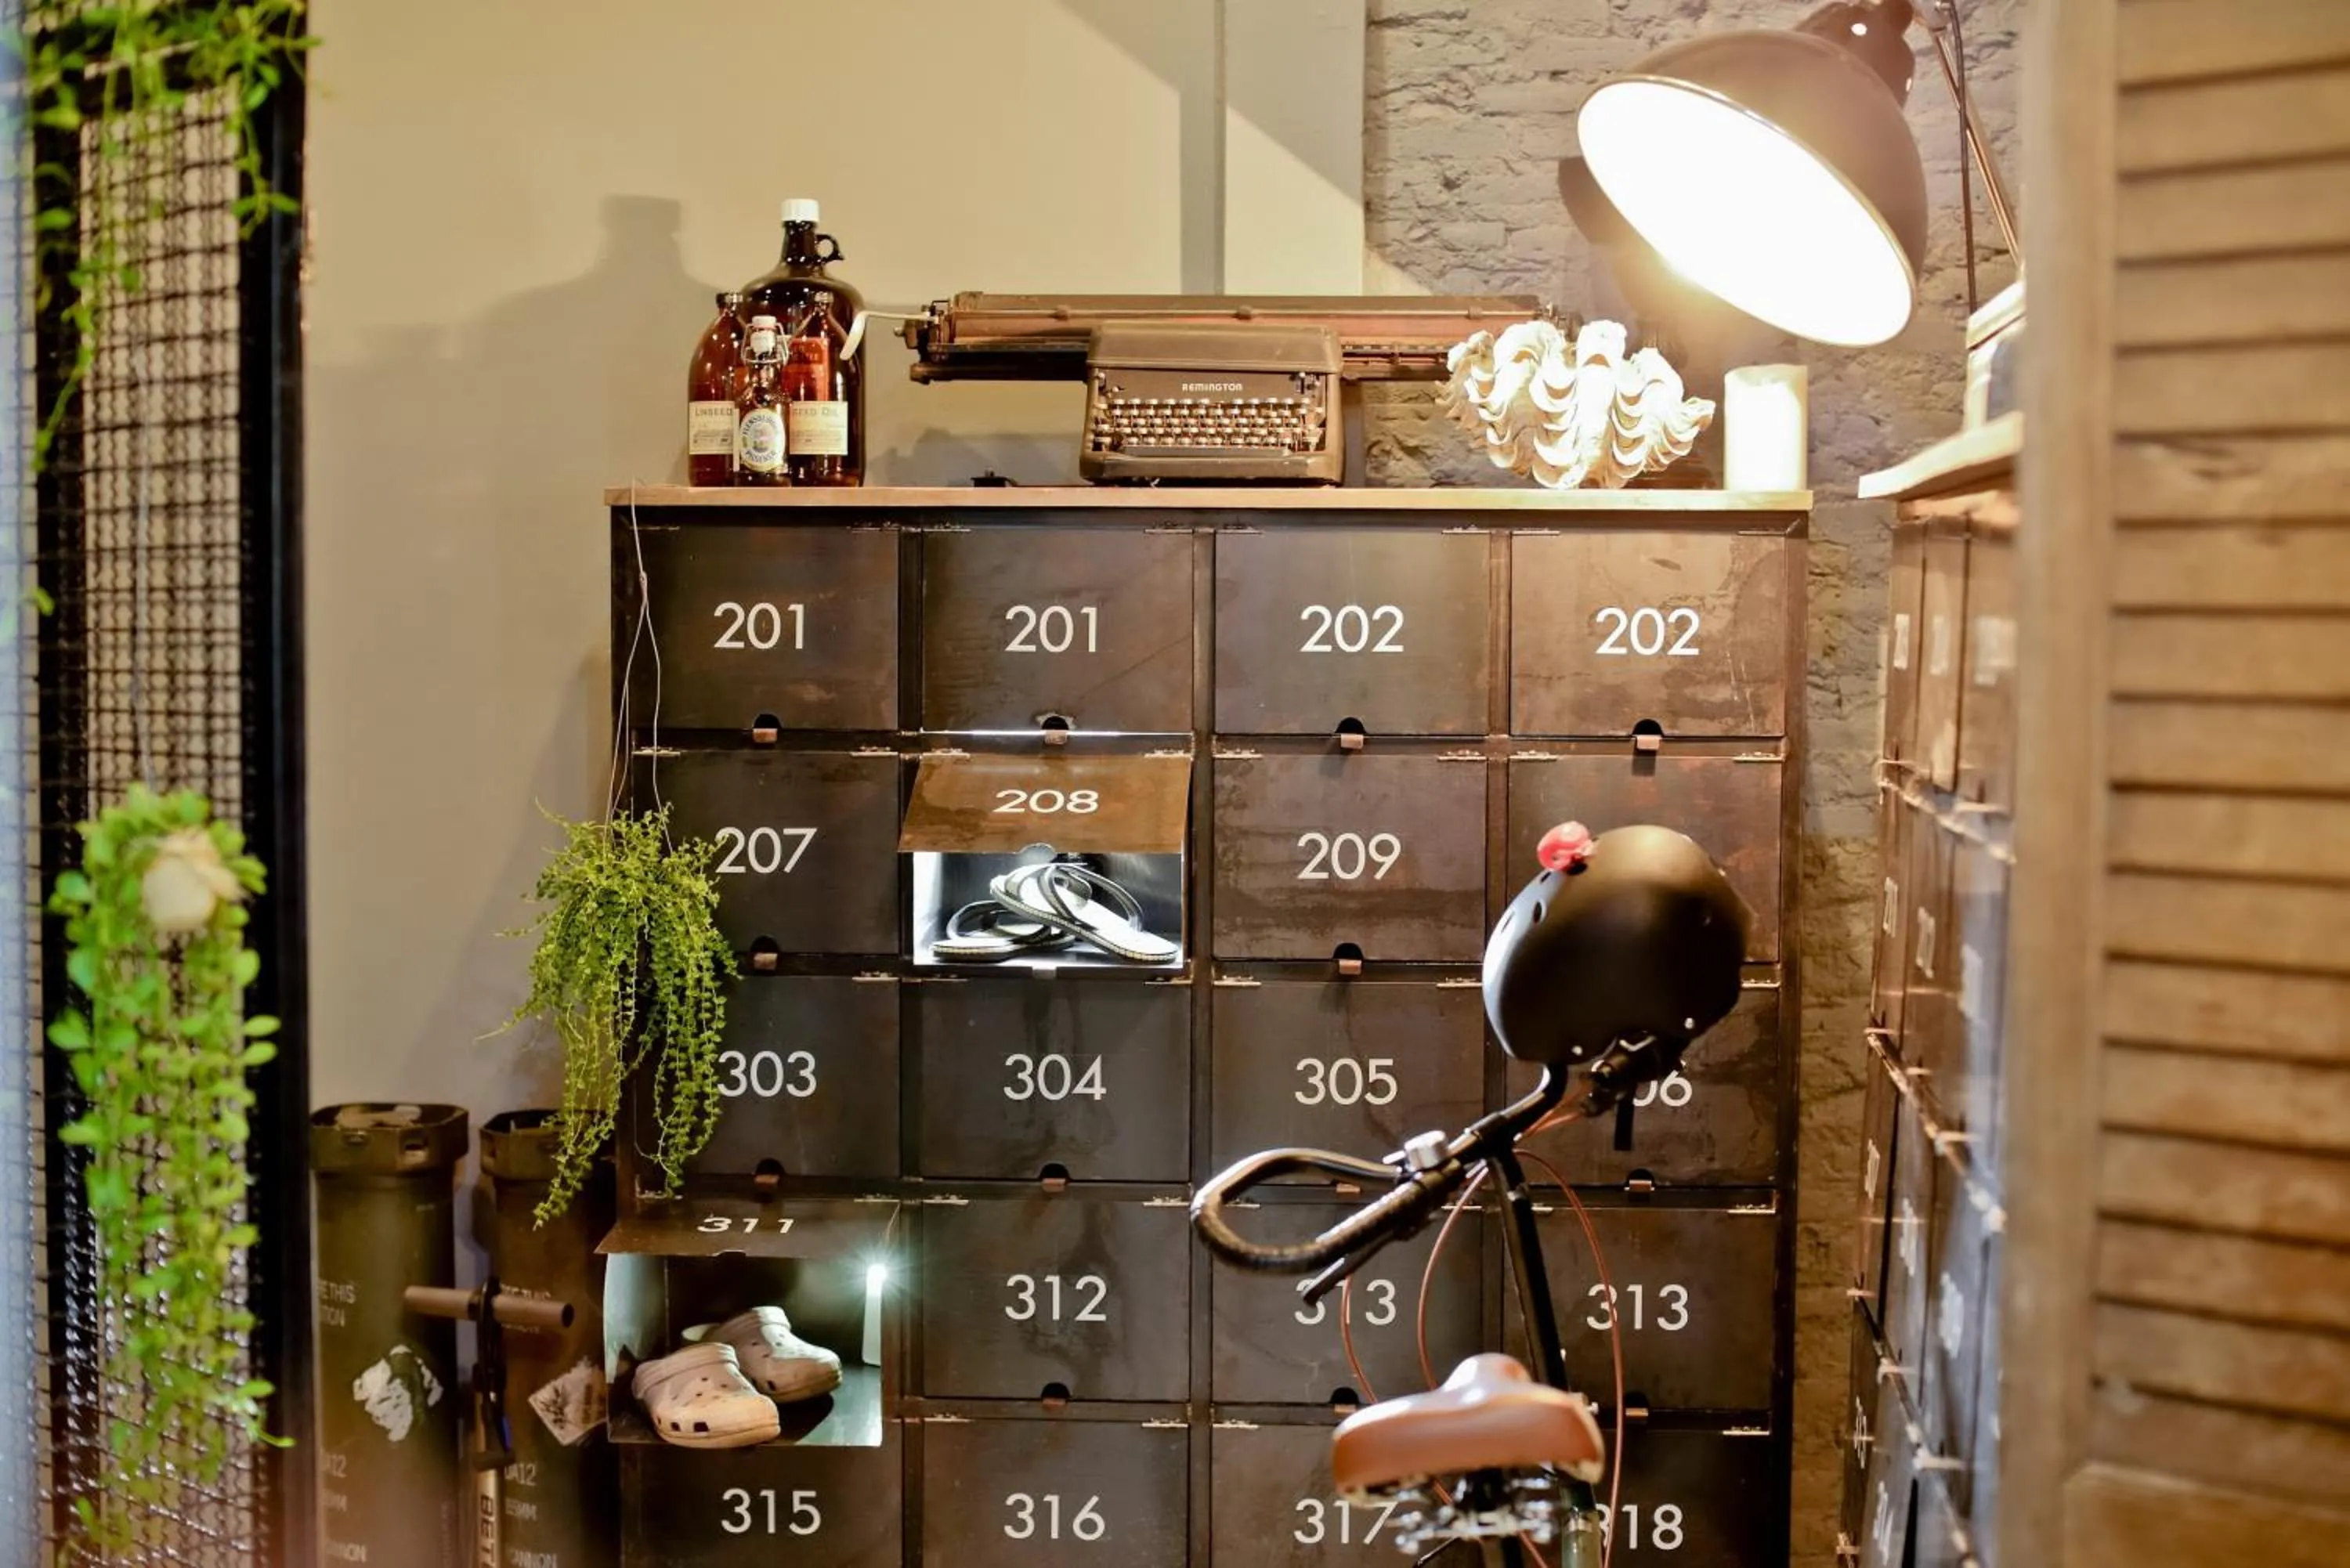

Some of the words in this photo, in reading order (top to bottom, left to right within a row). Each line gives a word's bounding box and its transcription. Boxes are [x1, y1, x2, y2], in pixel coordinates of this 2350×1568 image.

[1182, 383, 1243, 392] REMINGTON
[714, 602, 804, 649] 201
[1005, 605, 1097, 652] 201
[1300, 605, 1405, 652] 202
[1596, 607, 1700, 656] 202
[992, 789, 1099, 814] 208
[714, 826, 818, 873] 207
[1296, 832, 1401, 880] 209
[717, 1050, 817, 1097] 303
[1003, 1053, 1107, 1100] 304
[1295, 1057, 1397, 1105] 305
[697, 1217, 794, 1234] 311
[1005, 1274, 1107, 1321] 312
[1586, 1283, 1688, 1331] 313
[721, 1488, 821, 1535] 315
[1003, 1493, 1105, 1541] 316
[1294, 1498, 1398, 1545] 317
